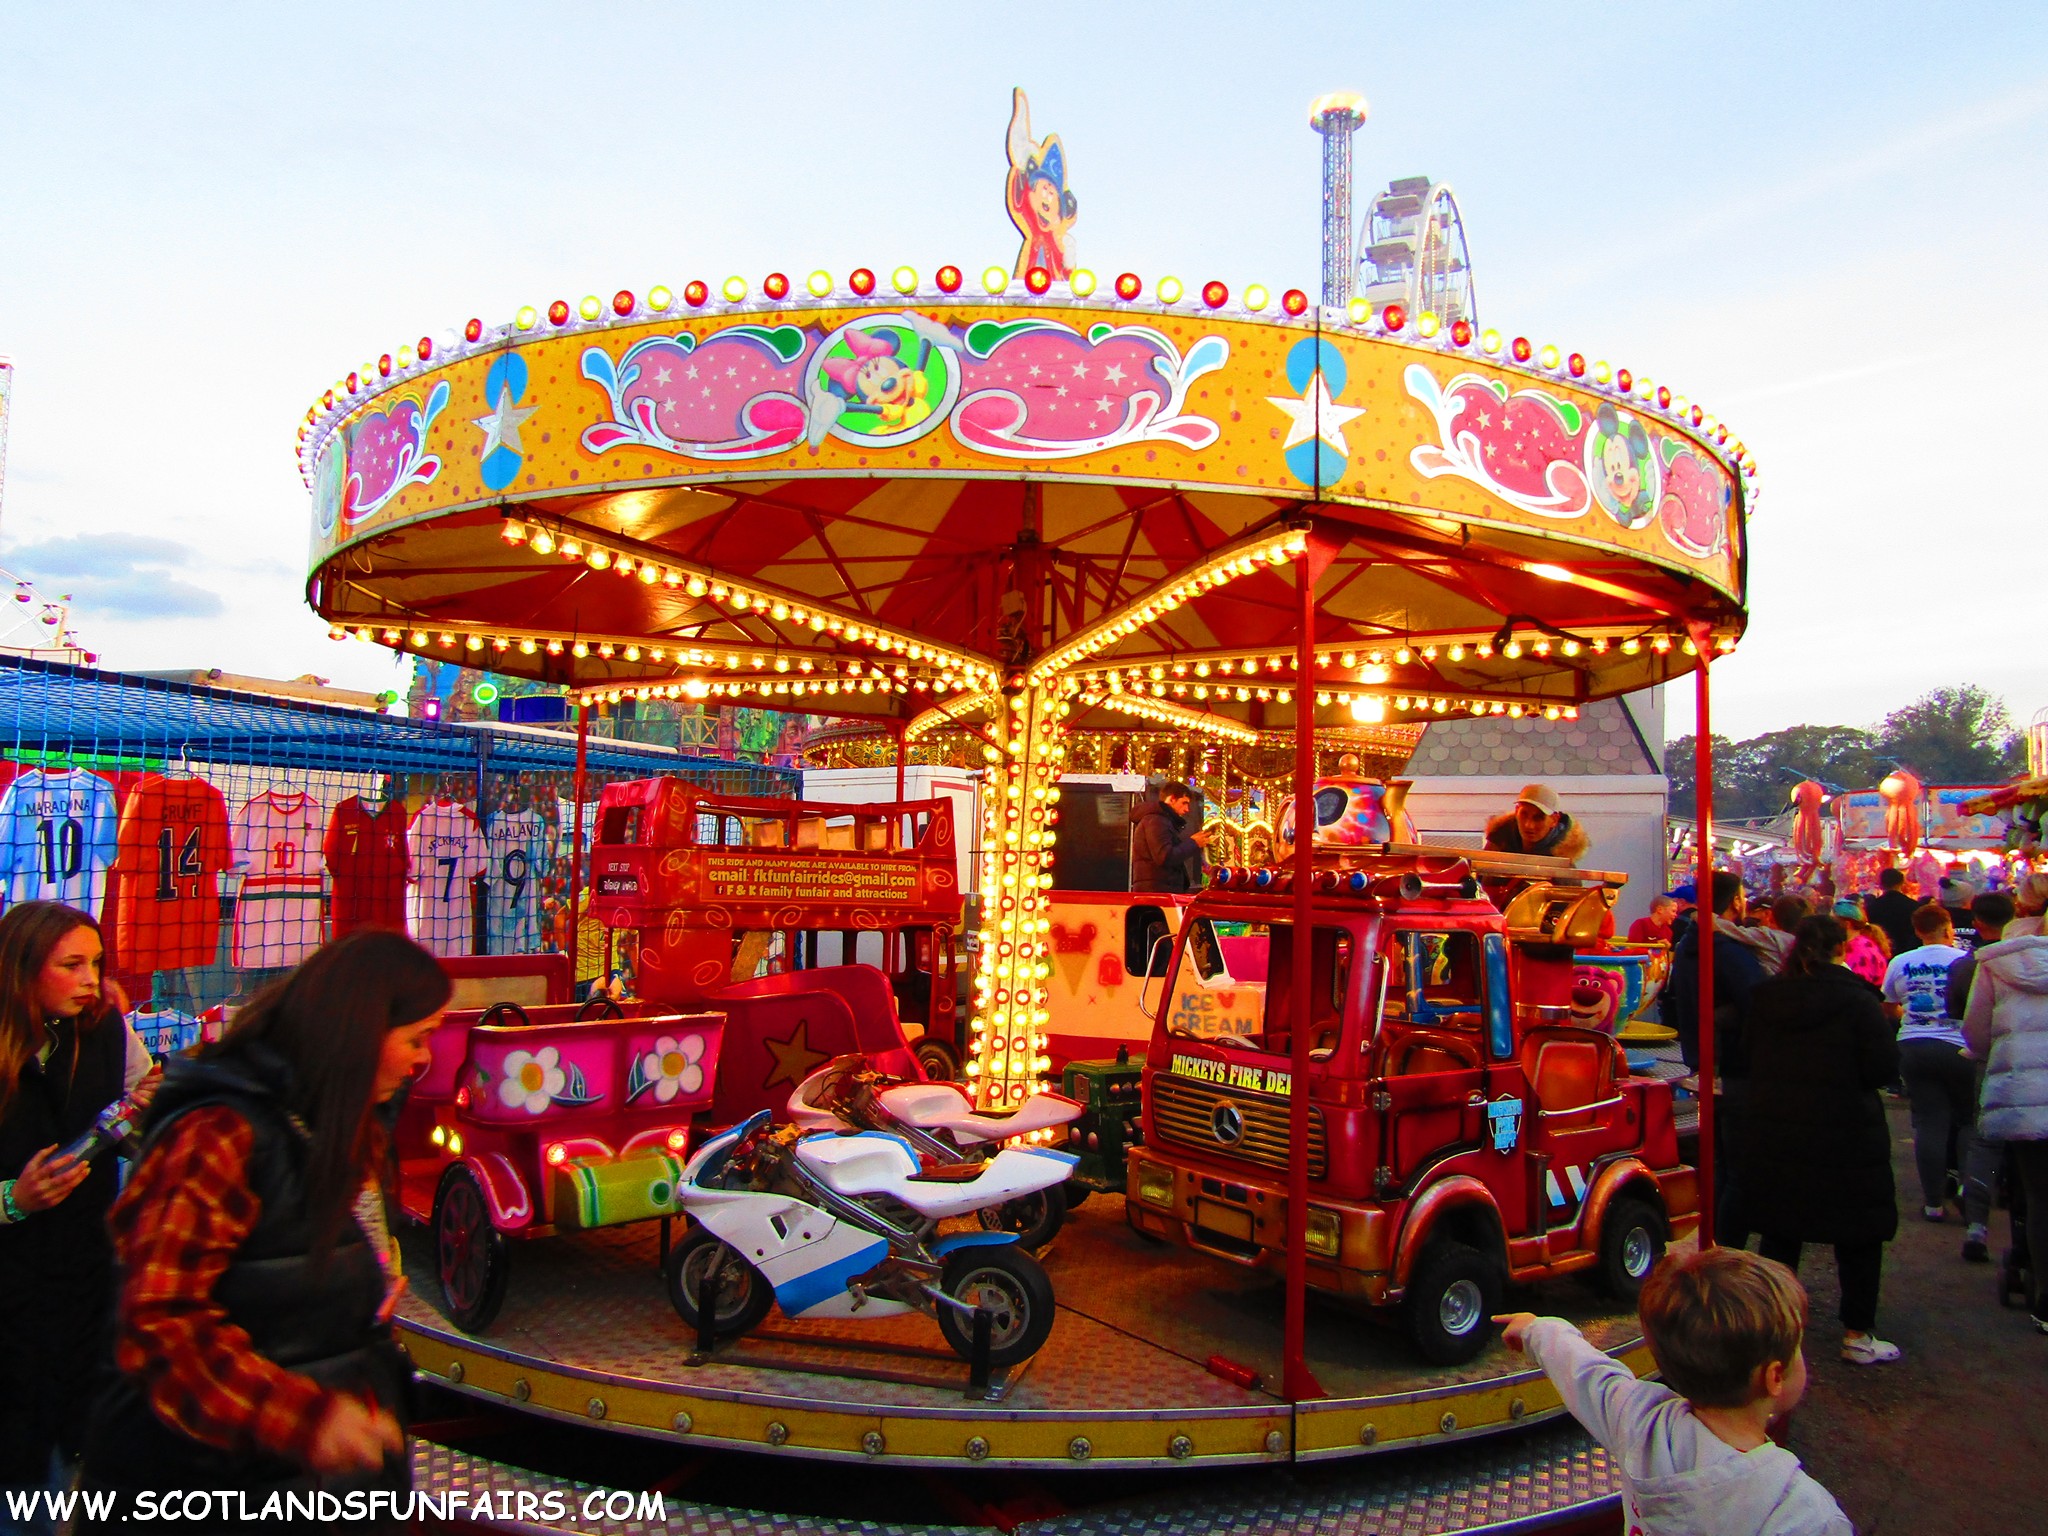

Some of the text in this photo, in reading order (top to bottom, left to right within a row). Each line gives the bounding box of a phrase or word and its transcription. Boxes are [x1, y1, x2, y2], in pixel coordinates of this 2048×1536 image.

[36, 818, 83, 884] 10
[274, 841, 296, 868] 10
[156, 826, 202, 901] 14
[707, 858, 725, 866] THIS
[726, 858, 744, 866] RIDE
[745, 859, 763, 867] AND
[764, 860, 788, 868] MANY
[790, 860, 810, 868] MORE
[811, 861, 826, 869] ARE
[828, 862, 869, 870] AVAILABLE
[871, 863, 879, 871] TO
[898, 864, 916, 872] FROM
[438, 857, 458, 902] 7
[503, 848, 527, 909] 9
[708, 868, 916, 887] email: fkfunfairrides@gmail.com
[760, 885, 793, 898] family
[796, 886, 831, 898] funfair
[833, 887, 853, 898] and
[855, 888, 908, 899] attractions
[1181, 992, 1214, 1012] ICE
[1173, 1012, 1253, 1034] CREAM
[139, 1033, 179, 1048] ADONA
[1171, 1053, 1226, 1083] MICKEYS
[1228, 1064, 1262, 1090] FIRE
